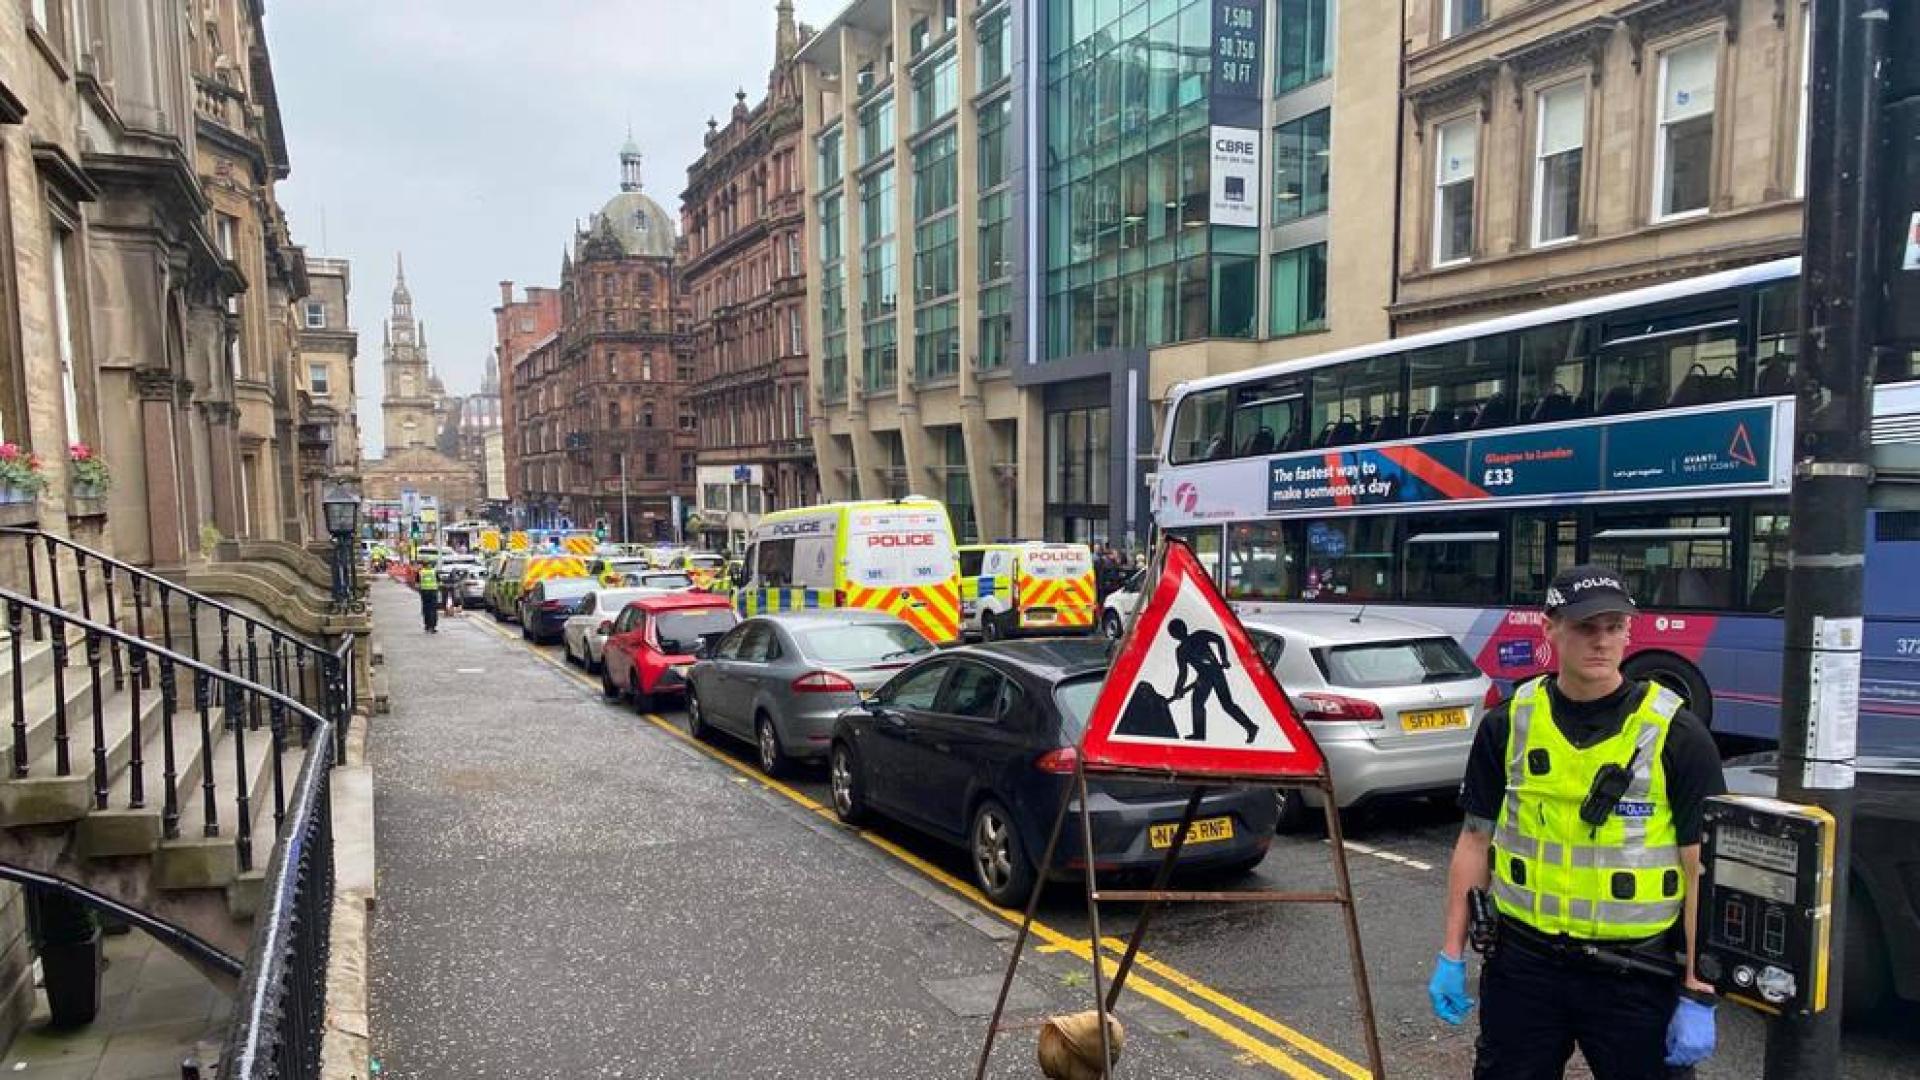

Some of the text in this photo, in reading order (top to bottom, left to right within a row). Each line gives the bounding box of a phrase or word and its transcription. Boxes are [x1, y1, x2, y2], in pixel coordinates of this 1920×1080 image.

[1223, 61, 1251, 83] SQ FT
[1215, 139, 1254, 156] CBRE
[1485, 447, 1573, 465] Glasgow to London
[1684, 453, 1717, 464] AVANTI
[1273, 460, 1376, 482] The fastest way to
[1710, 460, 1740, 471] COAST
[1484, 468, 1514, 487] £33
[1274, 477, 1392, 502] make someone's day
[774, 520, 820, 536] POLICE
[868, 533, 934, 549] POLICE
[1029, 551, 1084, 562] POLICE
[1574, 577, 1621, 592] POLICE
[1409, 712, 1435, 730] SF17
